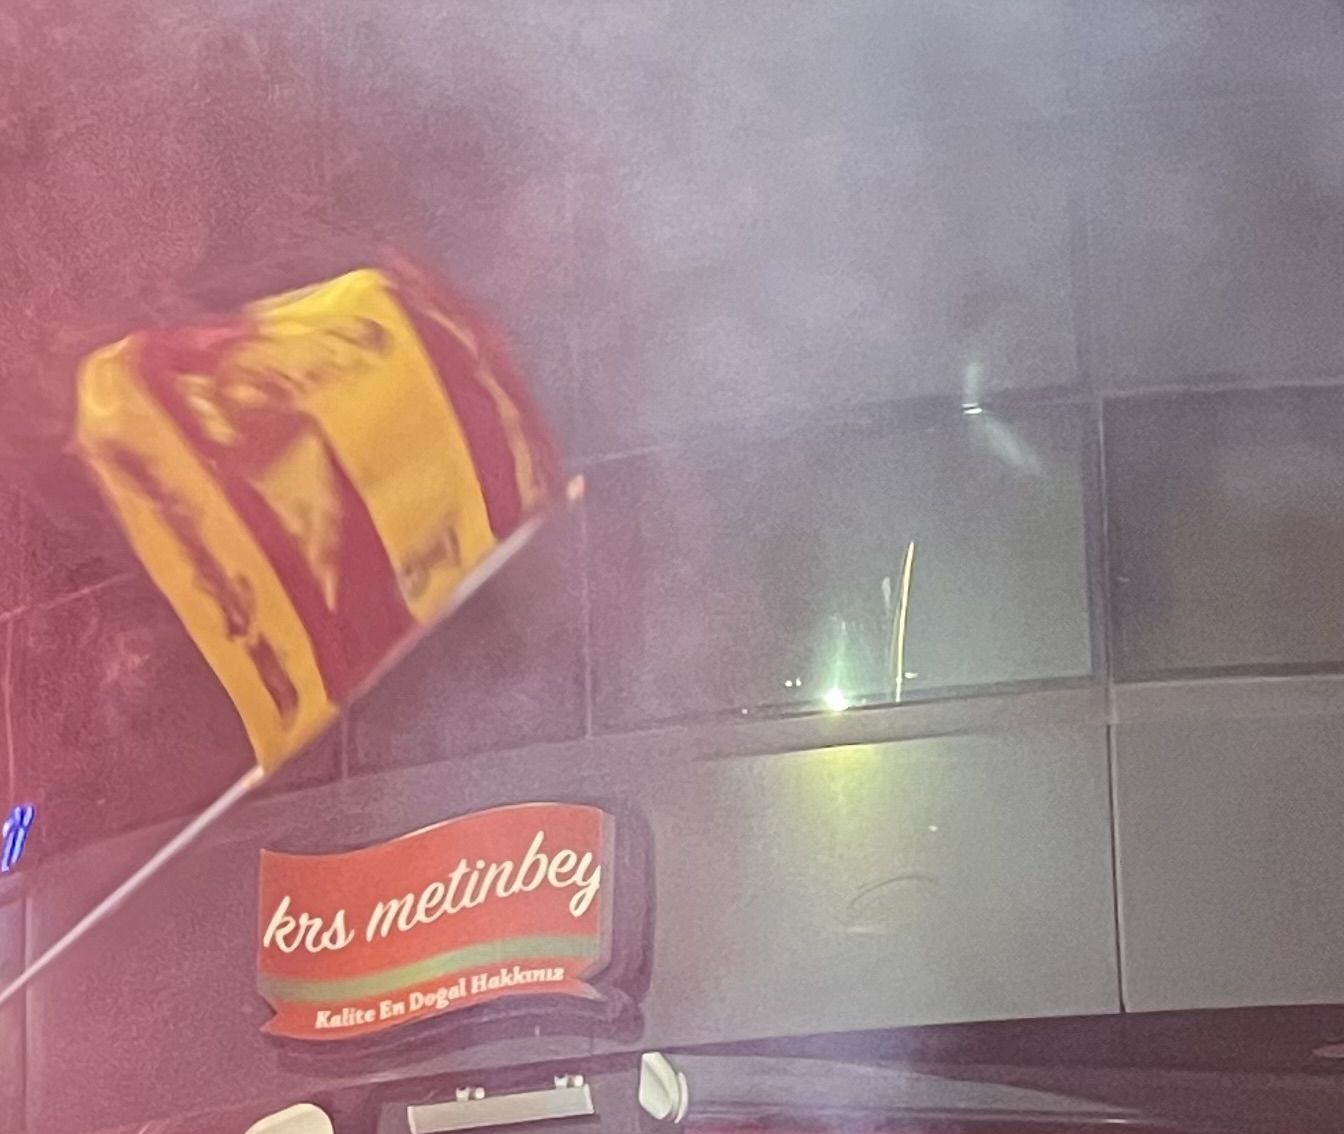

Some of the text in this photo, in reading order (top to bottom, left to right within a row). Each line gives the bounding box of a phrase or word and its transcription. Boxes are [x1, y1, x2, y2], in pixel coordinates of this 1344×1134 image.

[262, 830, 601, 954] krs metinbey
[315, 1006, 375, 1029] Kalite
[379, 999, 405, 1020] En
[471, 966, 564, 995] Hakkınız
